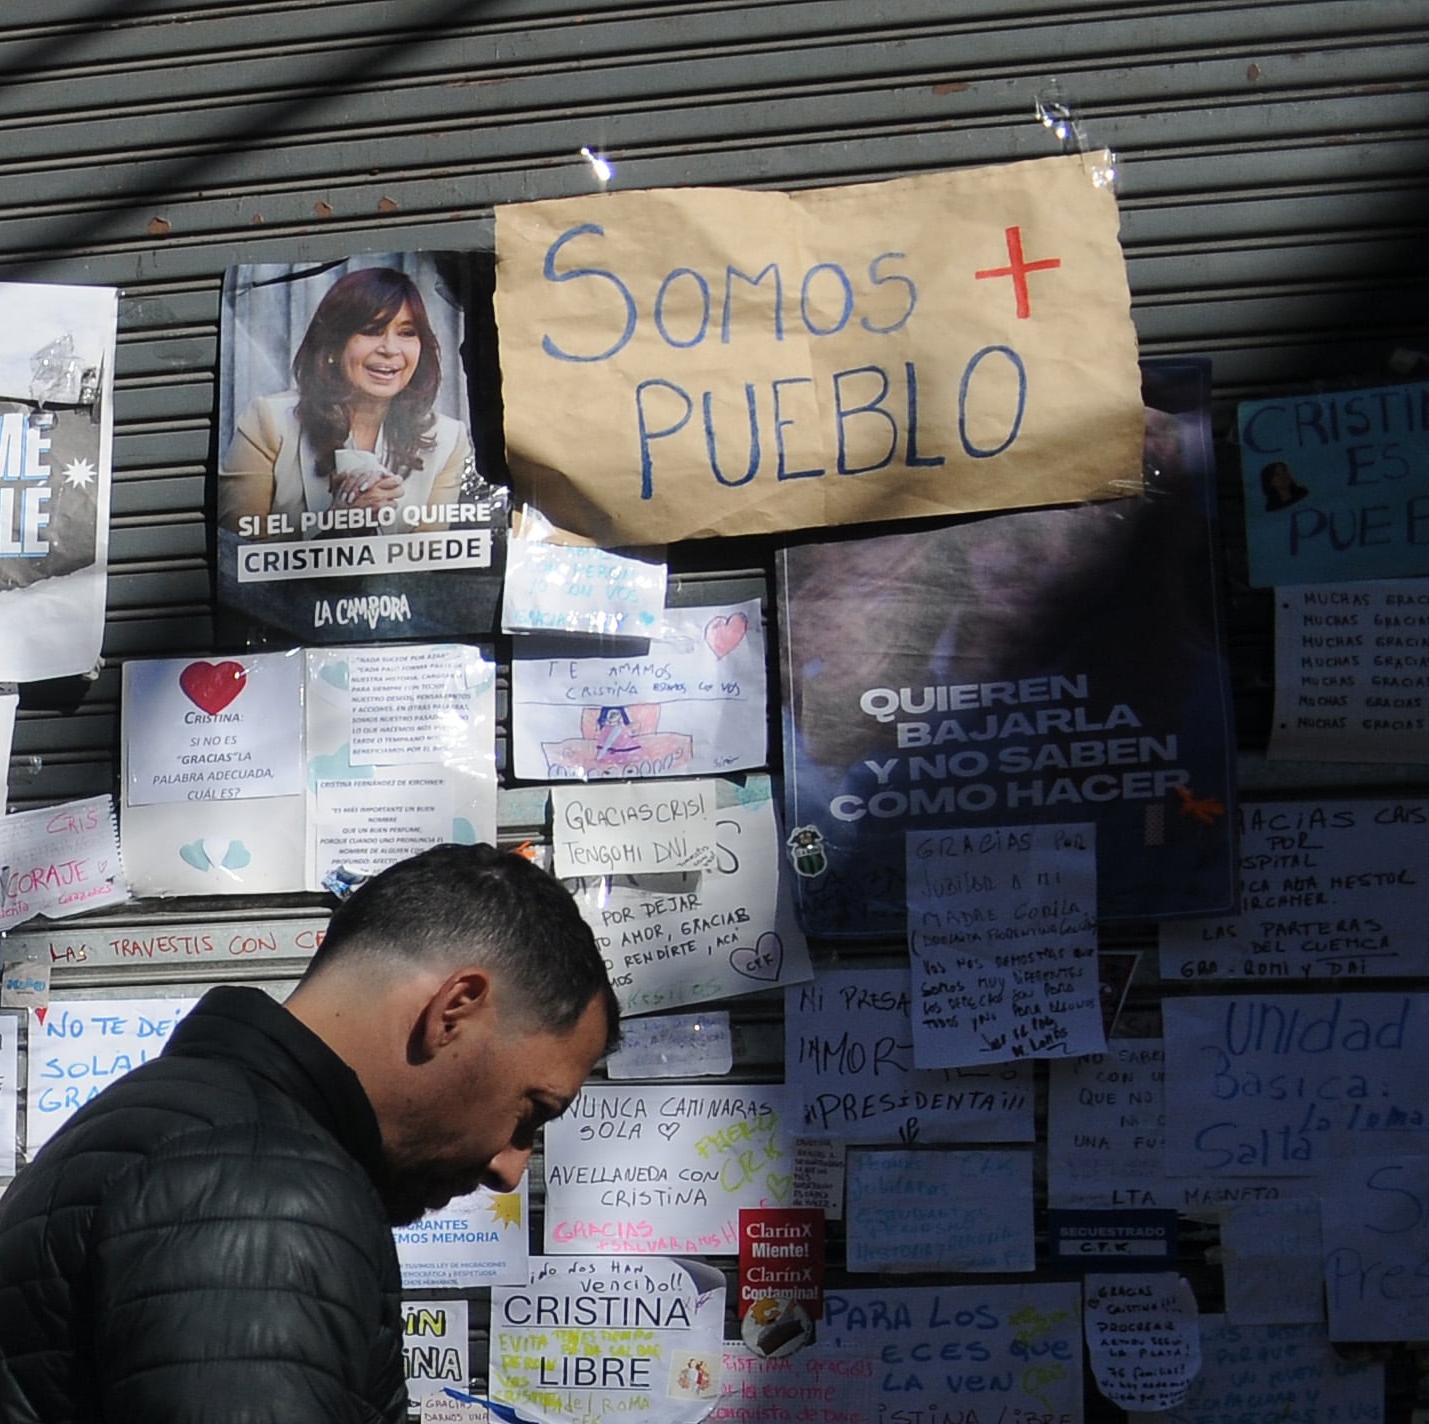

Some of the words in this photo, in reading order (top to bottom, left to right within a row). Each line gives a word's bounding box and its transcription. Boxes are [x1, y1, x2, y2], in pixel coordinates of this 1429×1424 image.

[635, 344, 1028, 500] PUEBLO
[238, 515, 264, 537] SI
[267, 513, 296, 534] EL
[301, 509, 396, 532] PUEBLO
[403, 503, 491, 524] QUIERE
[244, 544, 379, 574] CRISTINA
[386, 537, 482, 566] PUEDE
[314, 602, 333, 628] LA
[859, 673, 1089, 722] QUIEREN
[896, 703, 1143, 749] BAJARLA
[865, 759, 900, 784] Y
[908, 751, 992, 780] NO
[998, 734, 1179, 774] SABEN
[829, 778, 997, 823] CÓMO
[1005, 769, 1191, 804] HACER
[1059, 1225, 1167, 1239] SECUESTRADO
[751, 1243, 810, 1259] Miente!
[503, 1295, 691, 1328] CRISTINA
[539, 1357, 651, 1388] LIBRE
